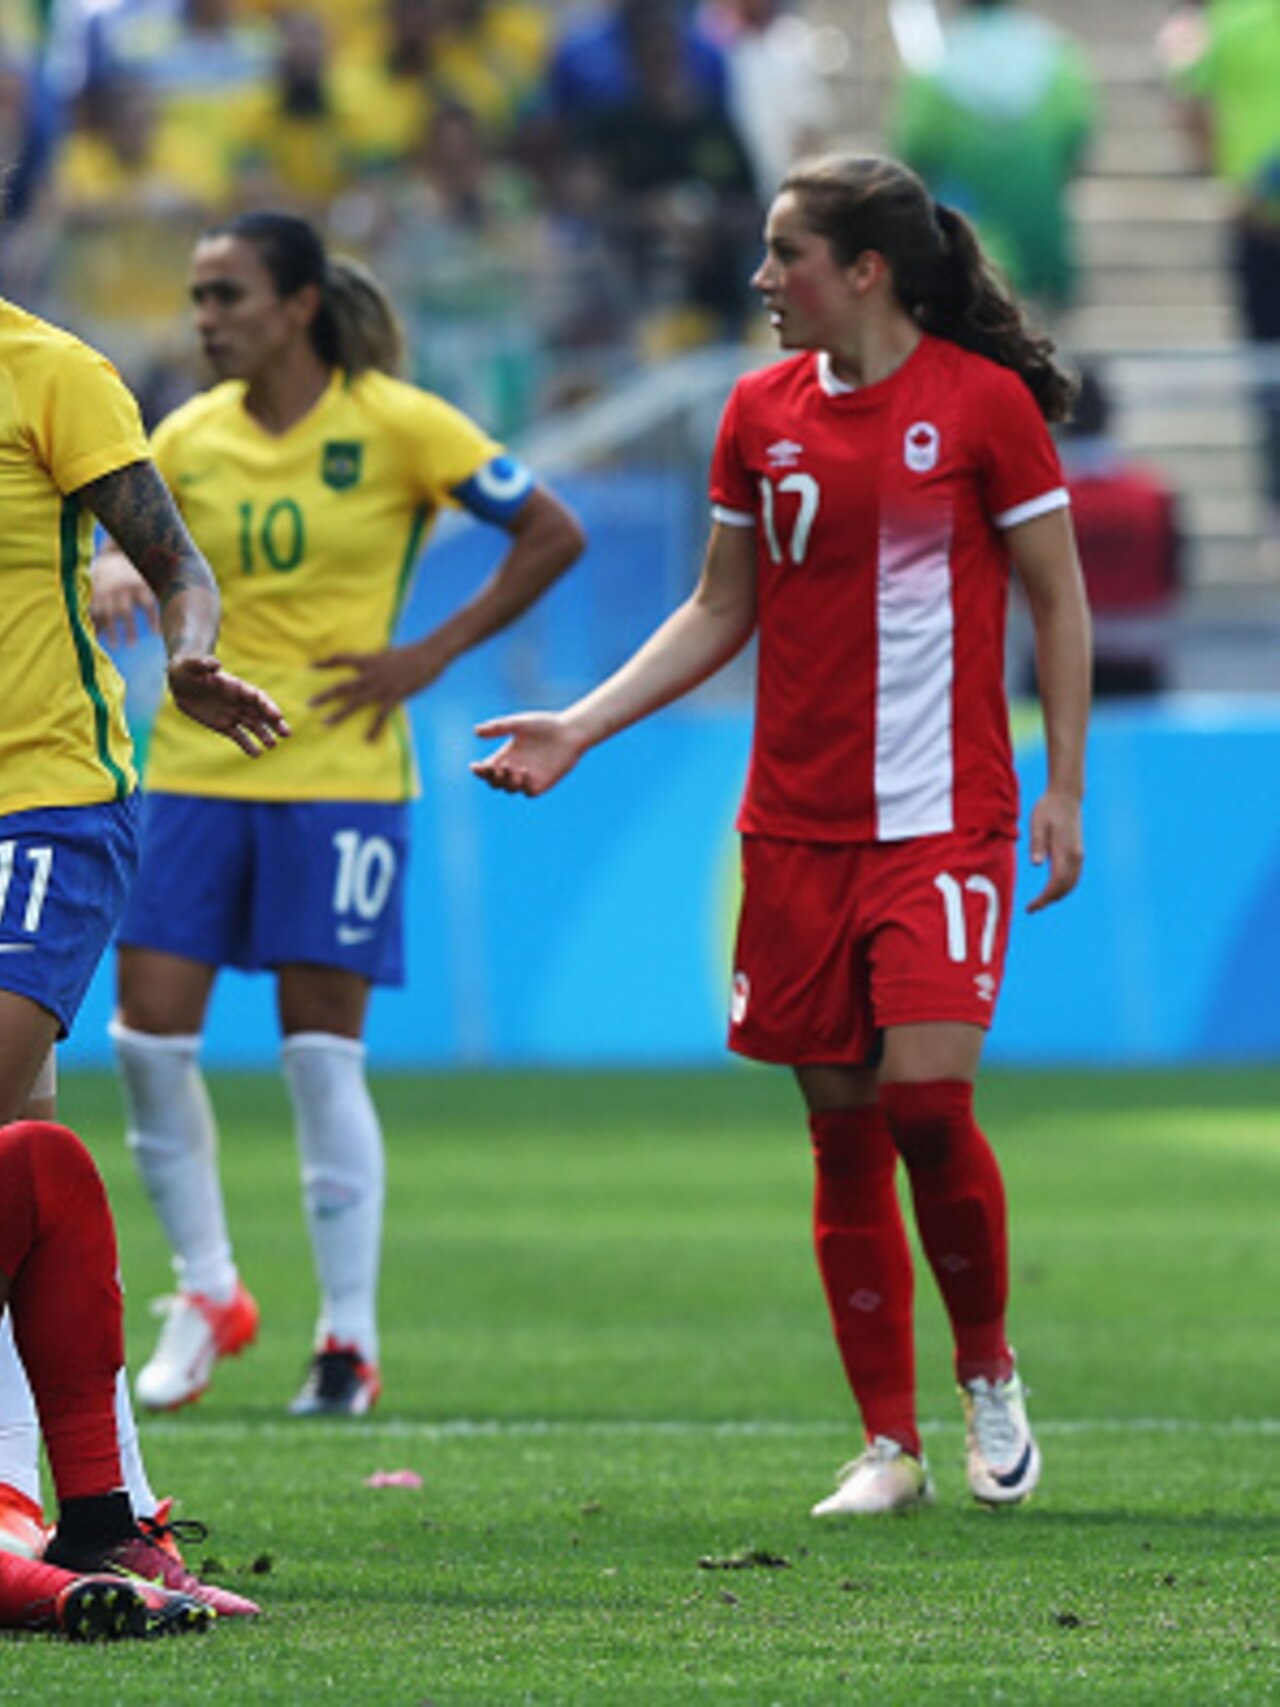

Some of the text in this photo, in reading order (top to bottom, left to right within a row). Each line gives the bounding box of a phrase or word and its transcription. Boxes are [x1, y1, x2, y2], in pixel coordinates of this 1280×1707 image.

[238, 499, 303, 575] 10
[760, 473, 819, 564] 17
[334, 830, 395, 918] 10
[934, 871, 999, 964] 17
